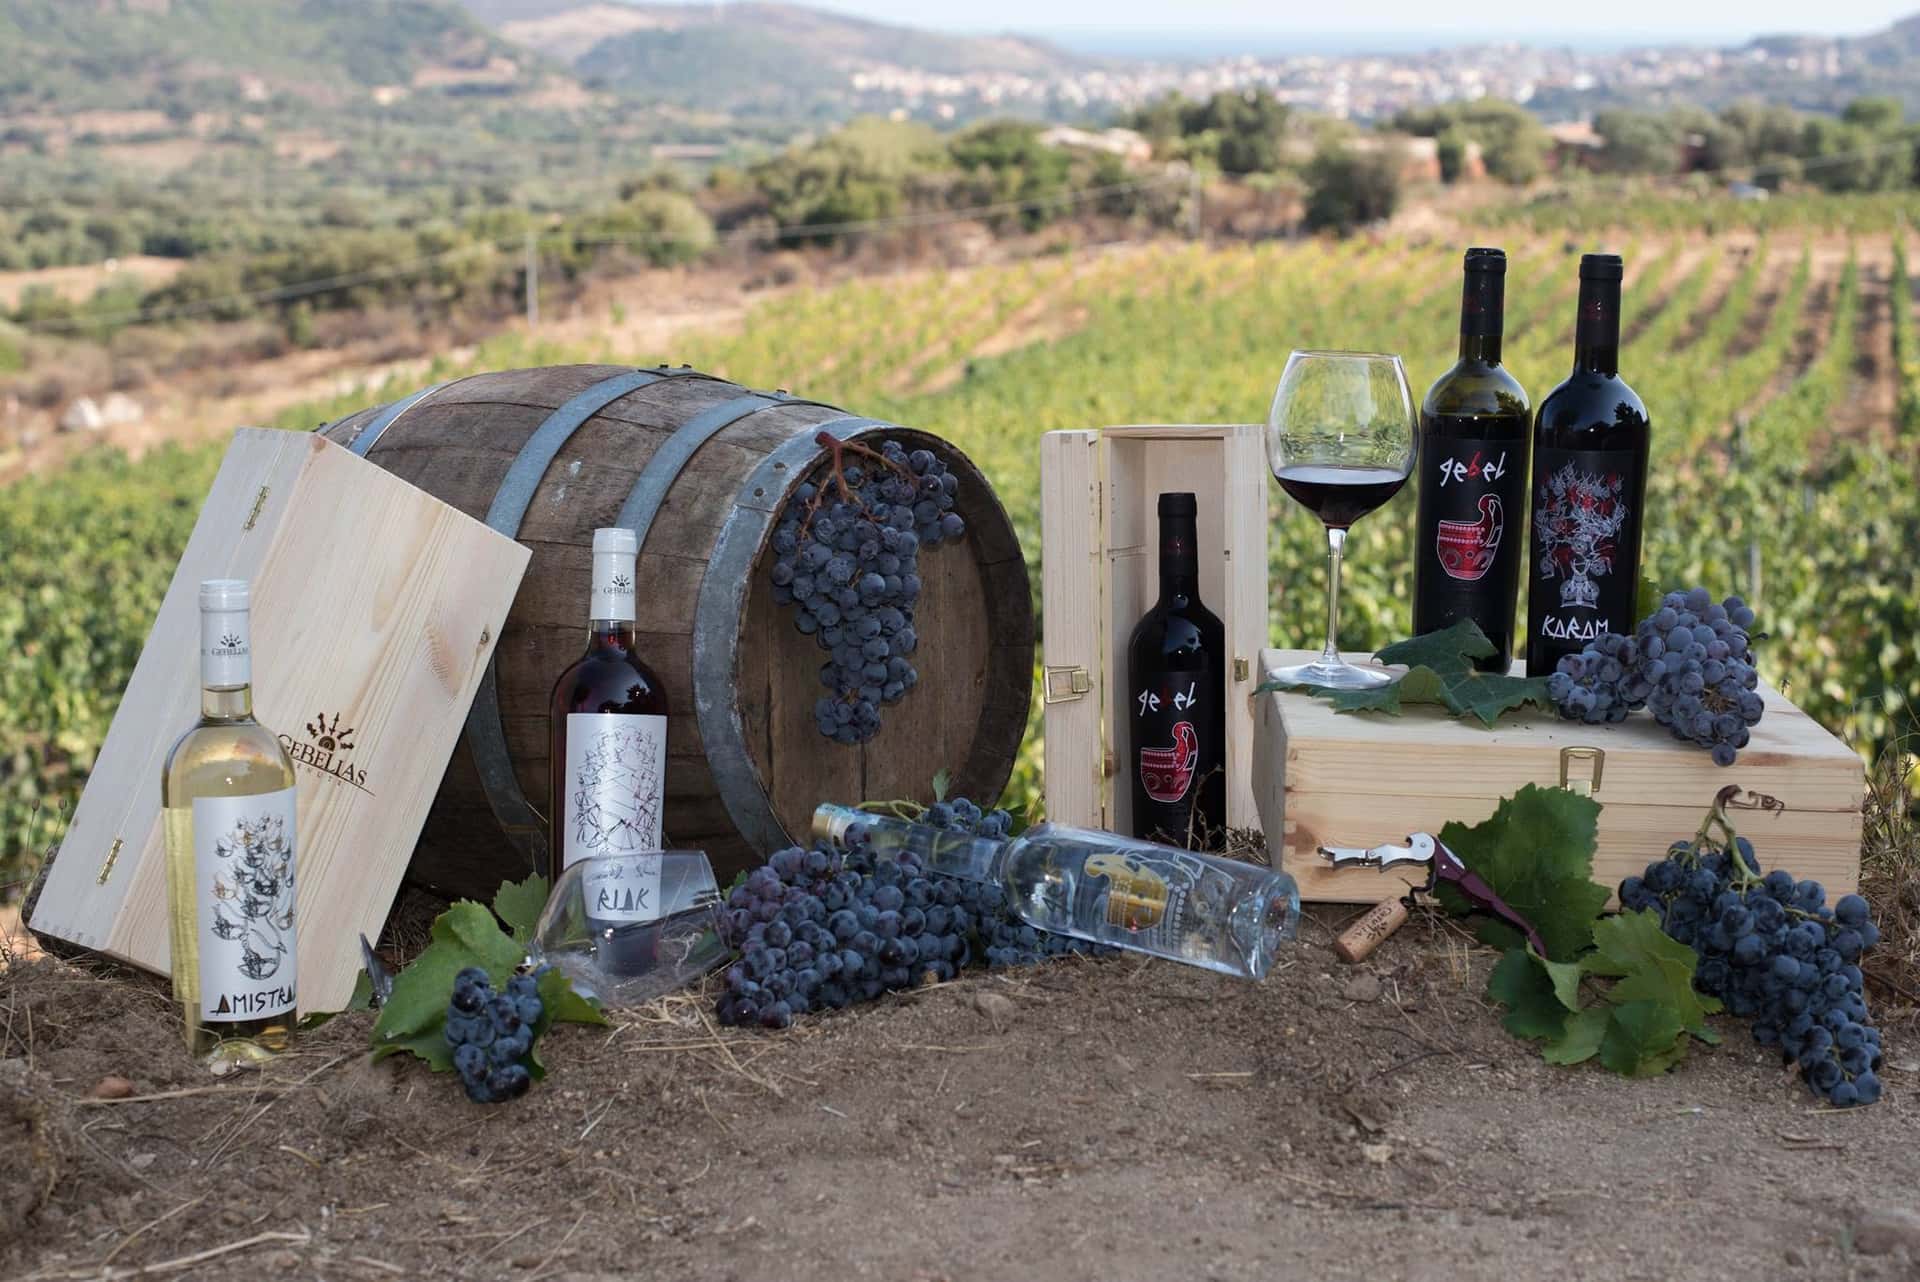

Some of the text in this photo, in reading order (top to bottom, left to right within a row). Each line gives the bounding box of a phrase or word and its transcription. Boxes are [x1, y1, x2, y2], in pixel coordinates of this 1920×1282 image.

[1440, 451, 1506, 487] gebel
[1542, 615, 1609, 642] KARAM
[597, 887, 650, 913] RIAK
